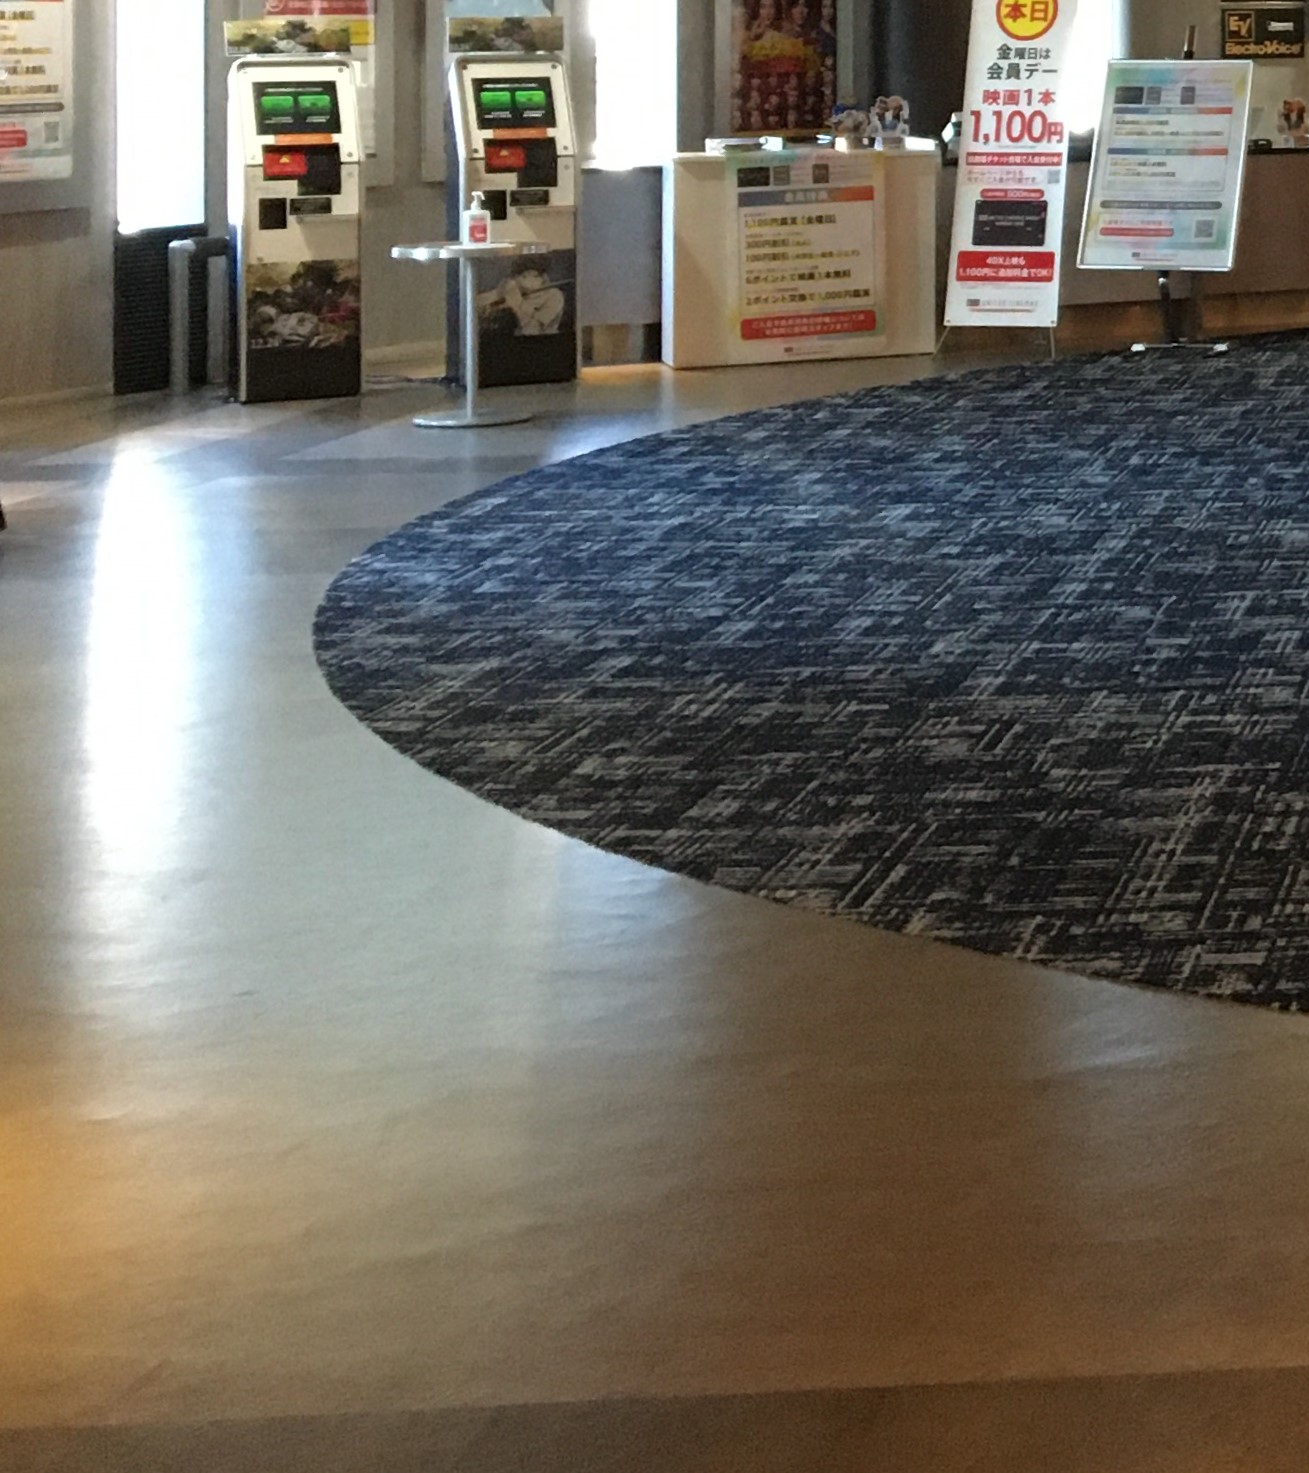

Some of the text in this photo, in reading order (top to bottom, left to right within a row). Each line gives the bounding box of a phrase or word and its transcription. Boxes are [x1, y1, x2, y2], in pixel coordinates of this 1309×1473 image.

[1003, 0, 1050, 22] 本日
[997, 43, 1052, 60] 金曜日は
[987, 62, 1058, 80] 会員デー
[982, 88, 1056, 107] 映画1本
[970, 109, 1064, 146] 1,100円
